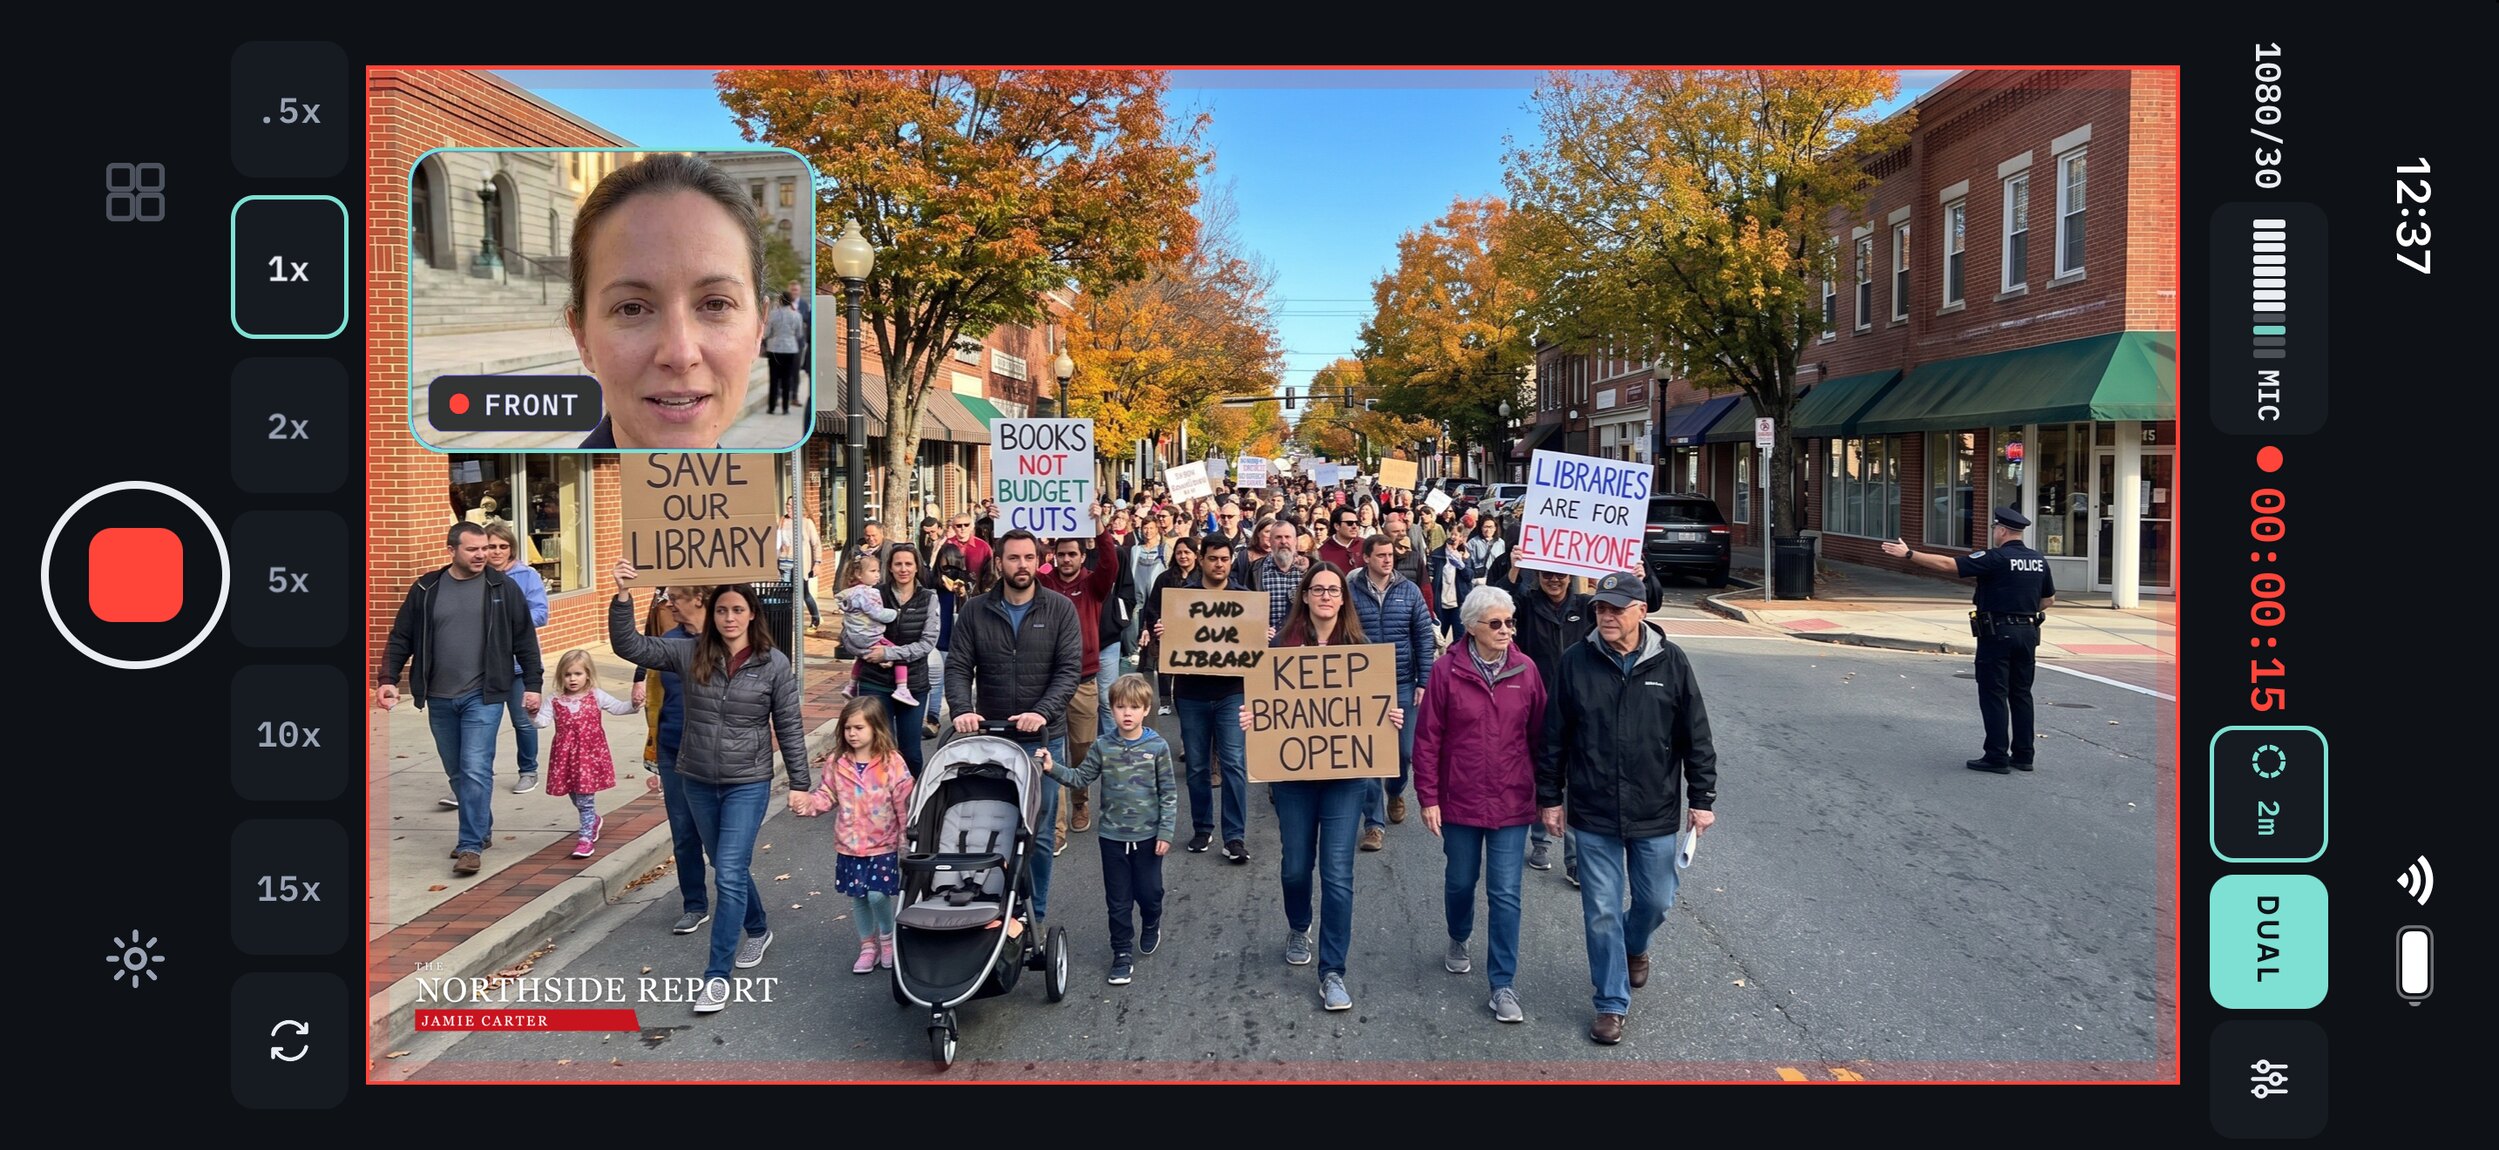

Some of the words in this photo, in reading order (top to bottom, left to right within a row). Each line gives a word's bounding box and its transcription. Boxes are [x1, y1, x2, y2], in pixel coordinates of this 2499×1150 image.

[262, 97, 321, 124] .5x
[2251, 43, 2284, 189] 1080/30
[2395, 157, 2432, 275] 12:37
[268, 255, 310, 282] 1x
[485, 393, 579, 418] FRONT
[2257, 369, 2281, 422] MIC
[268, 412, 309, 440] 2x
[1000, 423, 1087, 452] BOOKS
[647, 453, 748, 488] SAVE
[1019, 454, 1068, 476] NOT
[1535, 457, 1650, 500] LIBRARIES
[998, 479, 1089, 504] BUDGET
[663, 493, 730, 521] OUR
[1012, 507, 1077, 532] CUTS
[1540, 497, 1580, 520] ARE
[1592, 503, 1630, 527] FOR
[632, 526, 772, 570] LIBRARY
[1521, 525, 1640, 569] EVERYONE
[268, 566, 309, 593] 5x
[2010, 558, 2044, 573] POLICE
[1188, 601, 1245, 619] FUND
[2249, 487, 2287, 712] 00:00:15
[1194, 625, 1240, 644] OUR
[1169, 649, 1265, 669] LIBRARY
[1273, 652, 1370, 691] KEEP
[1252, 696, 1361, 732] BRANCH
[1371, 694, 1391, 727] 7
[257, 720, 321, 748] 10x
[1279, 734, 1374, 772] OPEN
[2257, 800, 2281, 836] 2m
[257, 875, 321, 902] 15x
[2256, 895, 2280, 983] DUAL
